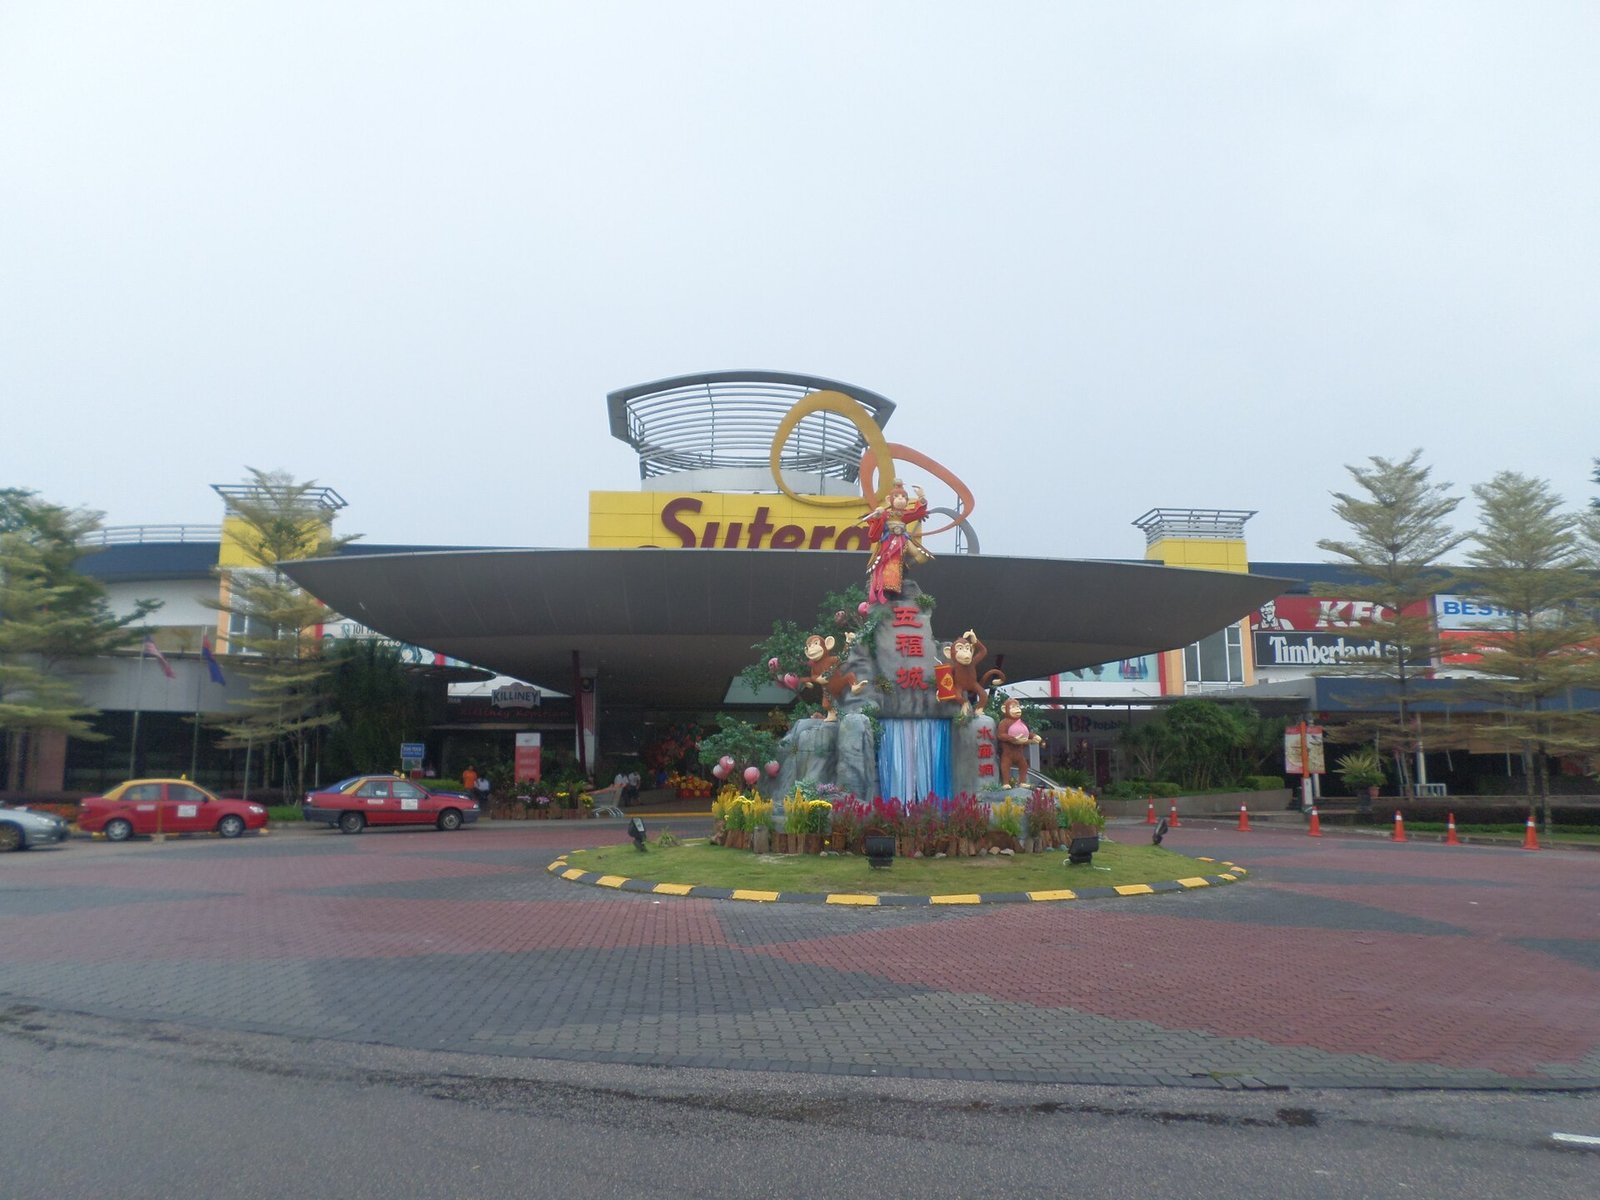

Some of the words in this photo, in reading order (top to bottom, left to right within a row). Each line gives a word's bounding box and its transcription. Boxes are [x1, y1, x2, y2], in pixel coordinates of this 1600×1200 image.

[1315, 600, 1396, 627] KFC
[891, 605, 929, 691] 五福城
[1269, 635, 1382, 664] Timberland
[493, 691, 538, 702] KILLINEY
